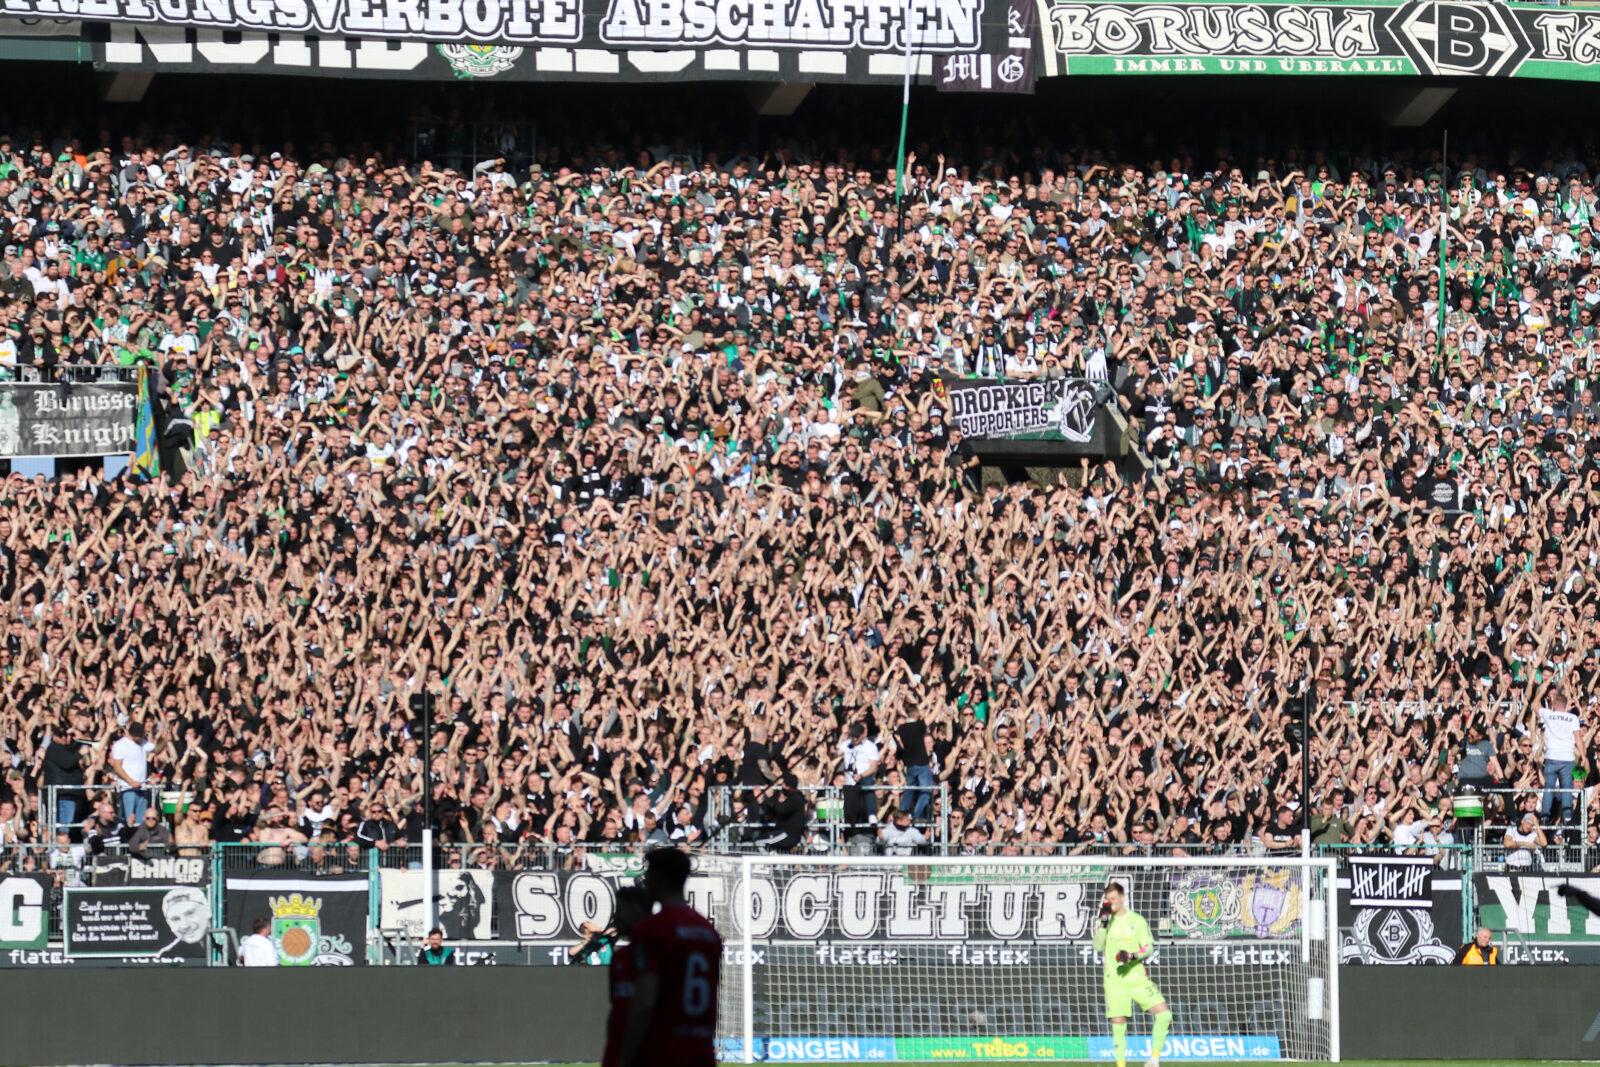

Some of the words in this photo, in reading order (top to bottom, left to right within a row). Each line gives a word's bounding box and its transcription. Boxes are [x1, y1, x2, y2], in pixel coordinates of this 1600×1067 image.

[600, 0, 985, 49] ABSCHAFFEN
[1050, 5, 1379, 58] BORUSSIA
[1113, 58, 1207, 73] IMMER
[1218, 59, 1267, 72] UND
[1278, 58, 1403, 73] ÜBERALL!
[961, 407, 1049, 438] SUPPORTERS
[512, 871, 1137, 939] SOTOCULTUR
[816, 946, 898, 965] flatex
[948, 945, 1029, 965] flatex
[1210, 945, 1290, 965] flatex
[682, 952, 710, 1016] 6
